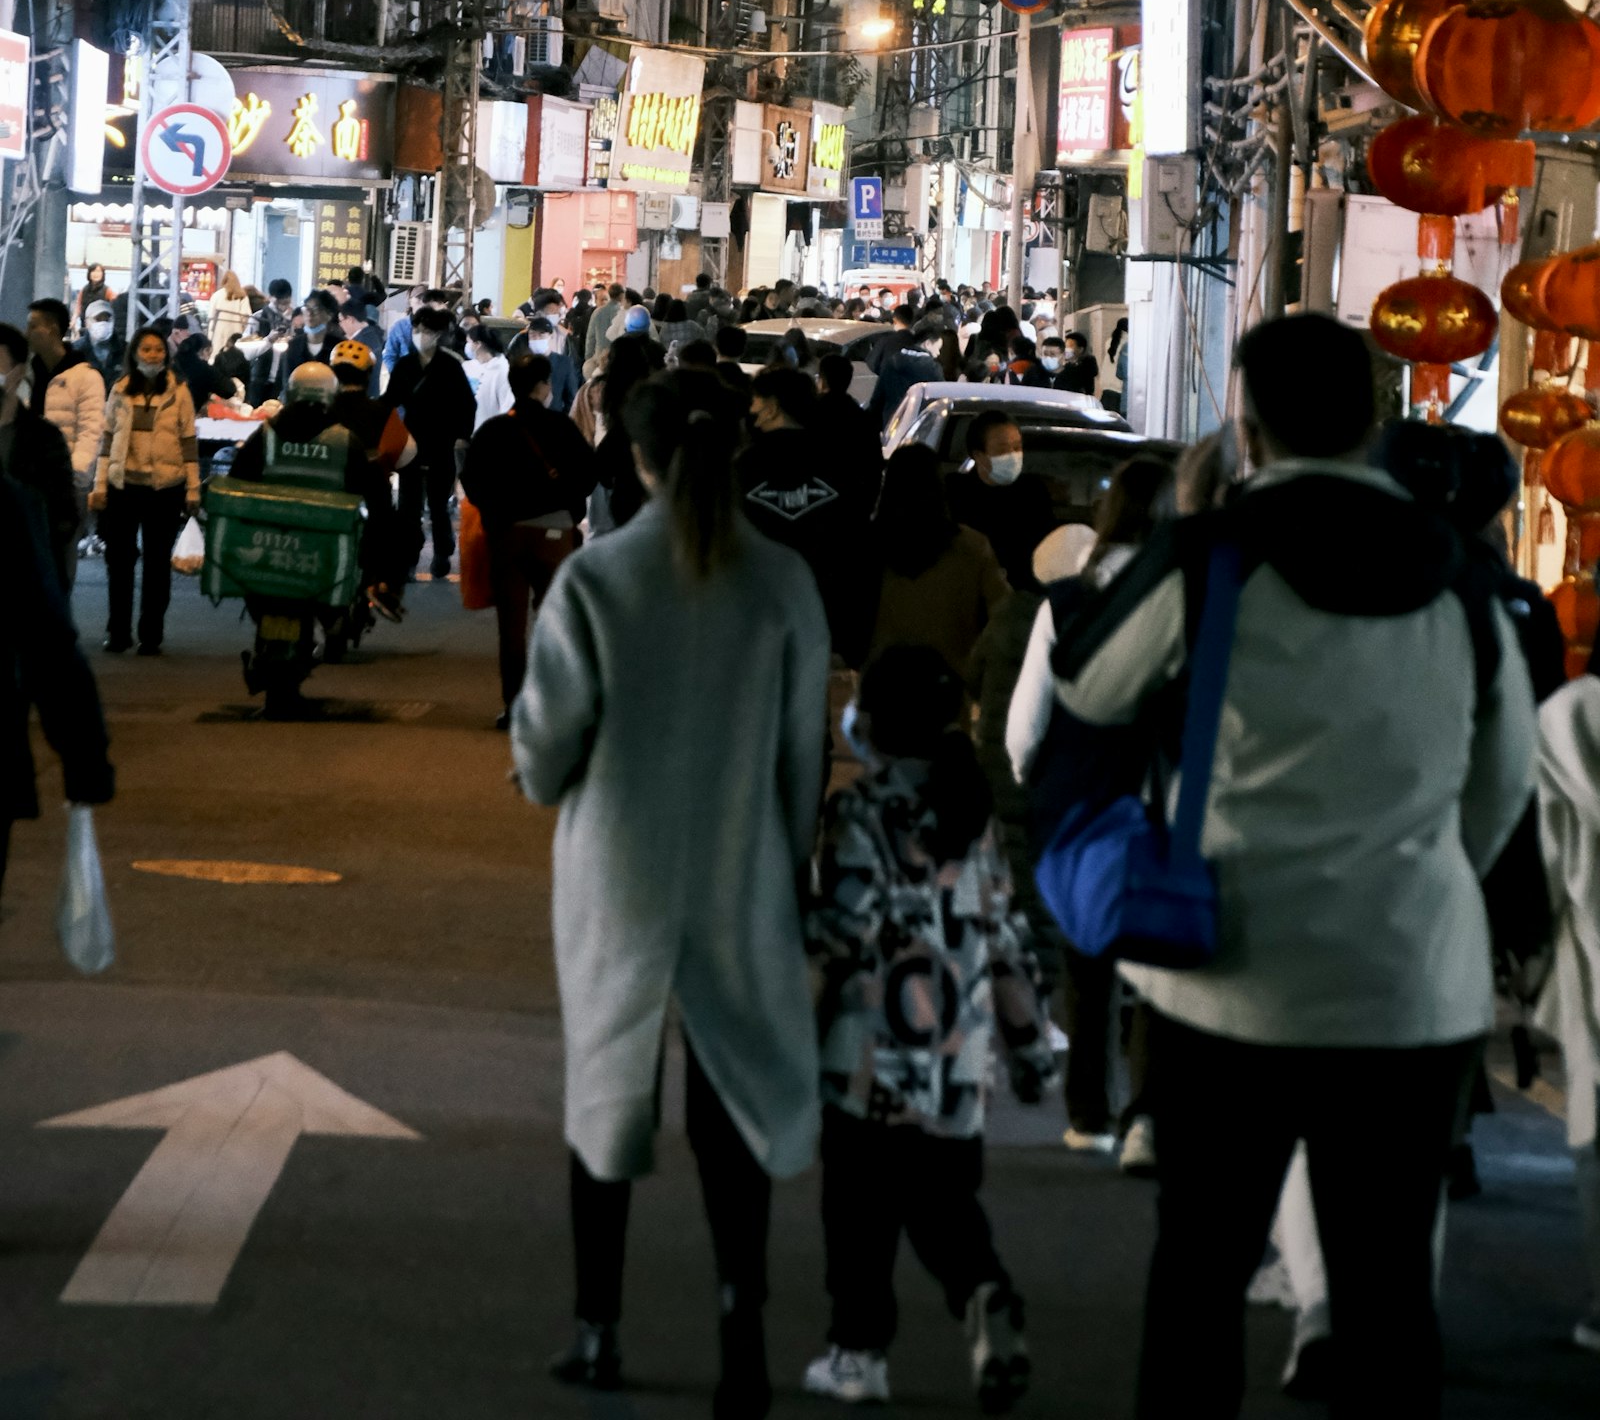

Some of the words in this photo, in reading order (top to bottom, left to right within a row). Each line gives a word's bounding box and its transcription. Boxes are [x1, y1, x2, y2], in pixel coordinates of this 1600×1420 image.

[860, 184, 876, 214] P
[318, 267, 349, 281] 海鲜
[281, 440, 329, 459] 01171
[252, 531, 300, 551] 01171
